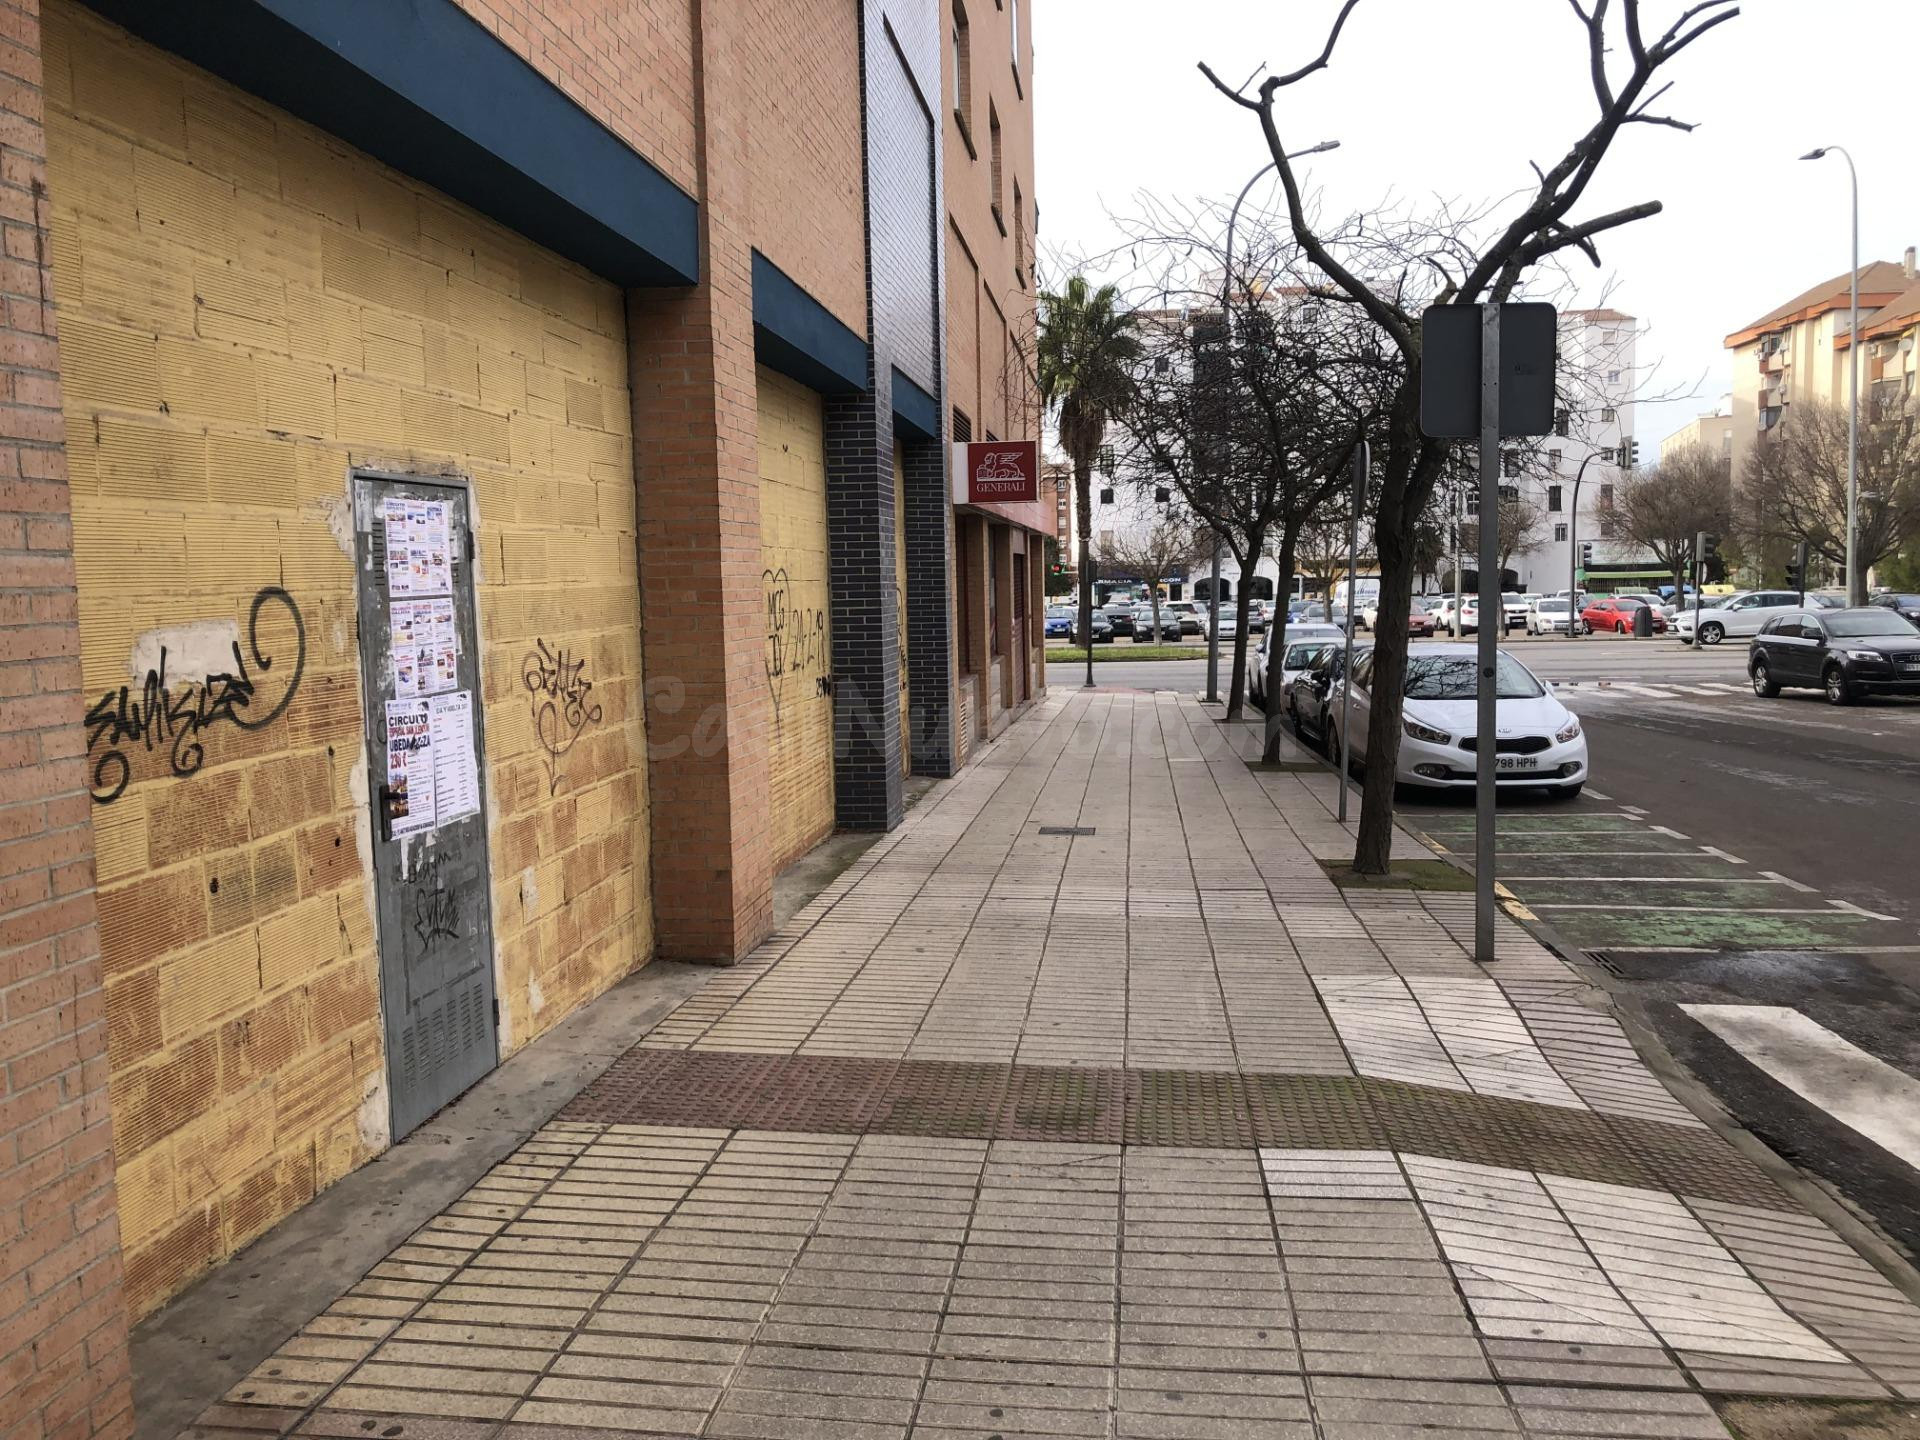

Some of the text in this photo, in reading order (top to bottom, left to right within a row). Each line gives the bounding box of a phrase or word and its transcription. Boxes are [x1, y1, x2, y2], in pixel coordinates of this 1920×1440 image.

[976, 482, 1025, 492] GENERALI
[388, 713, 428, 727] CIRCUITO
[1495, 757, 1538, 769] 798 HPH
